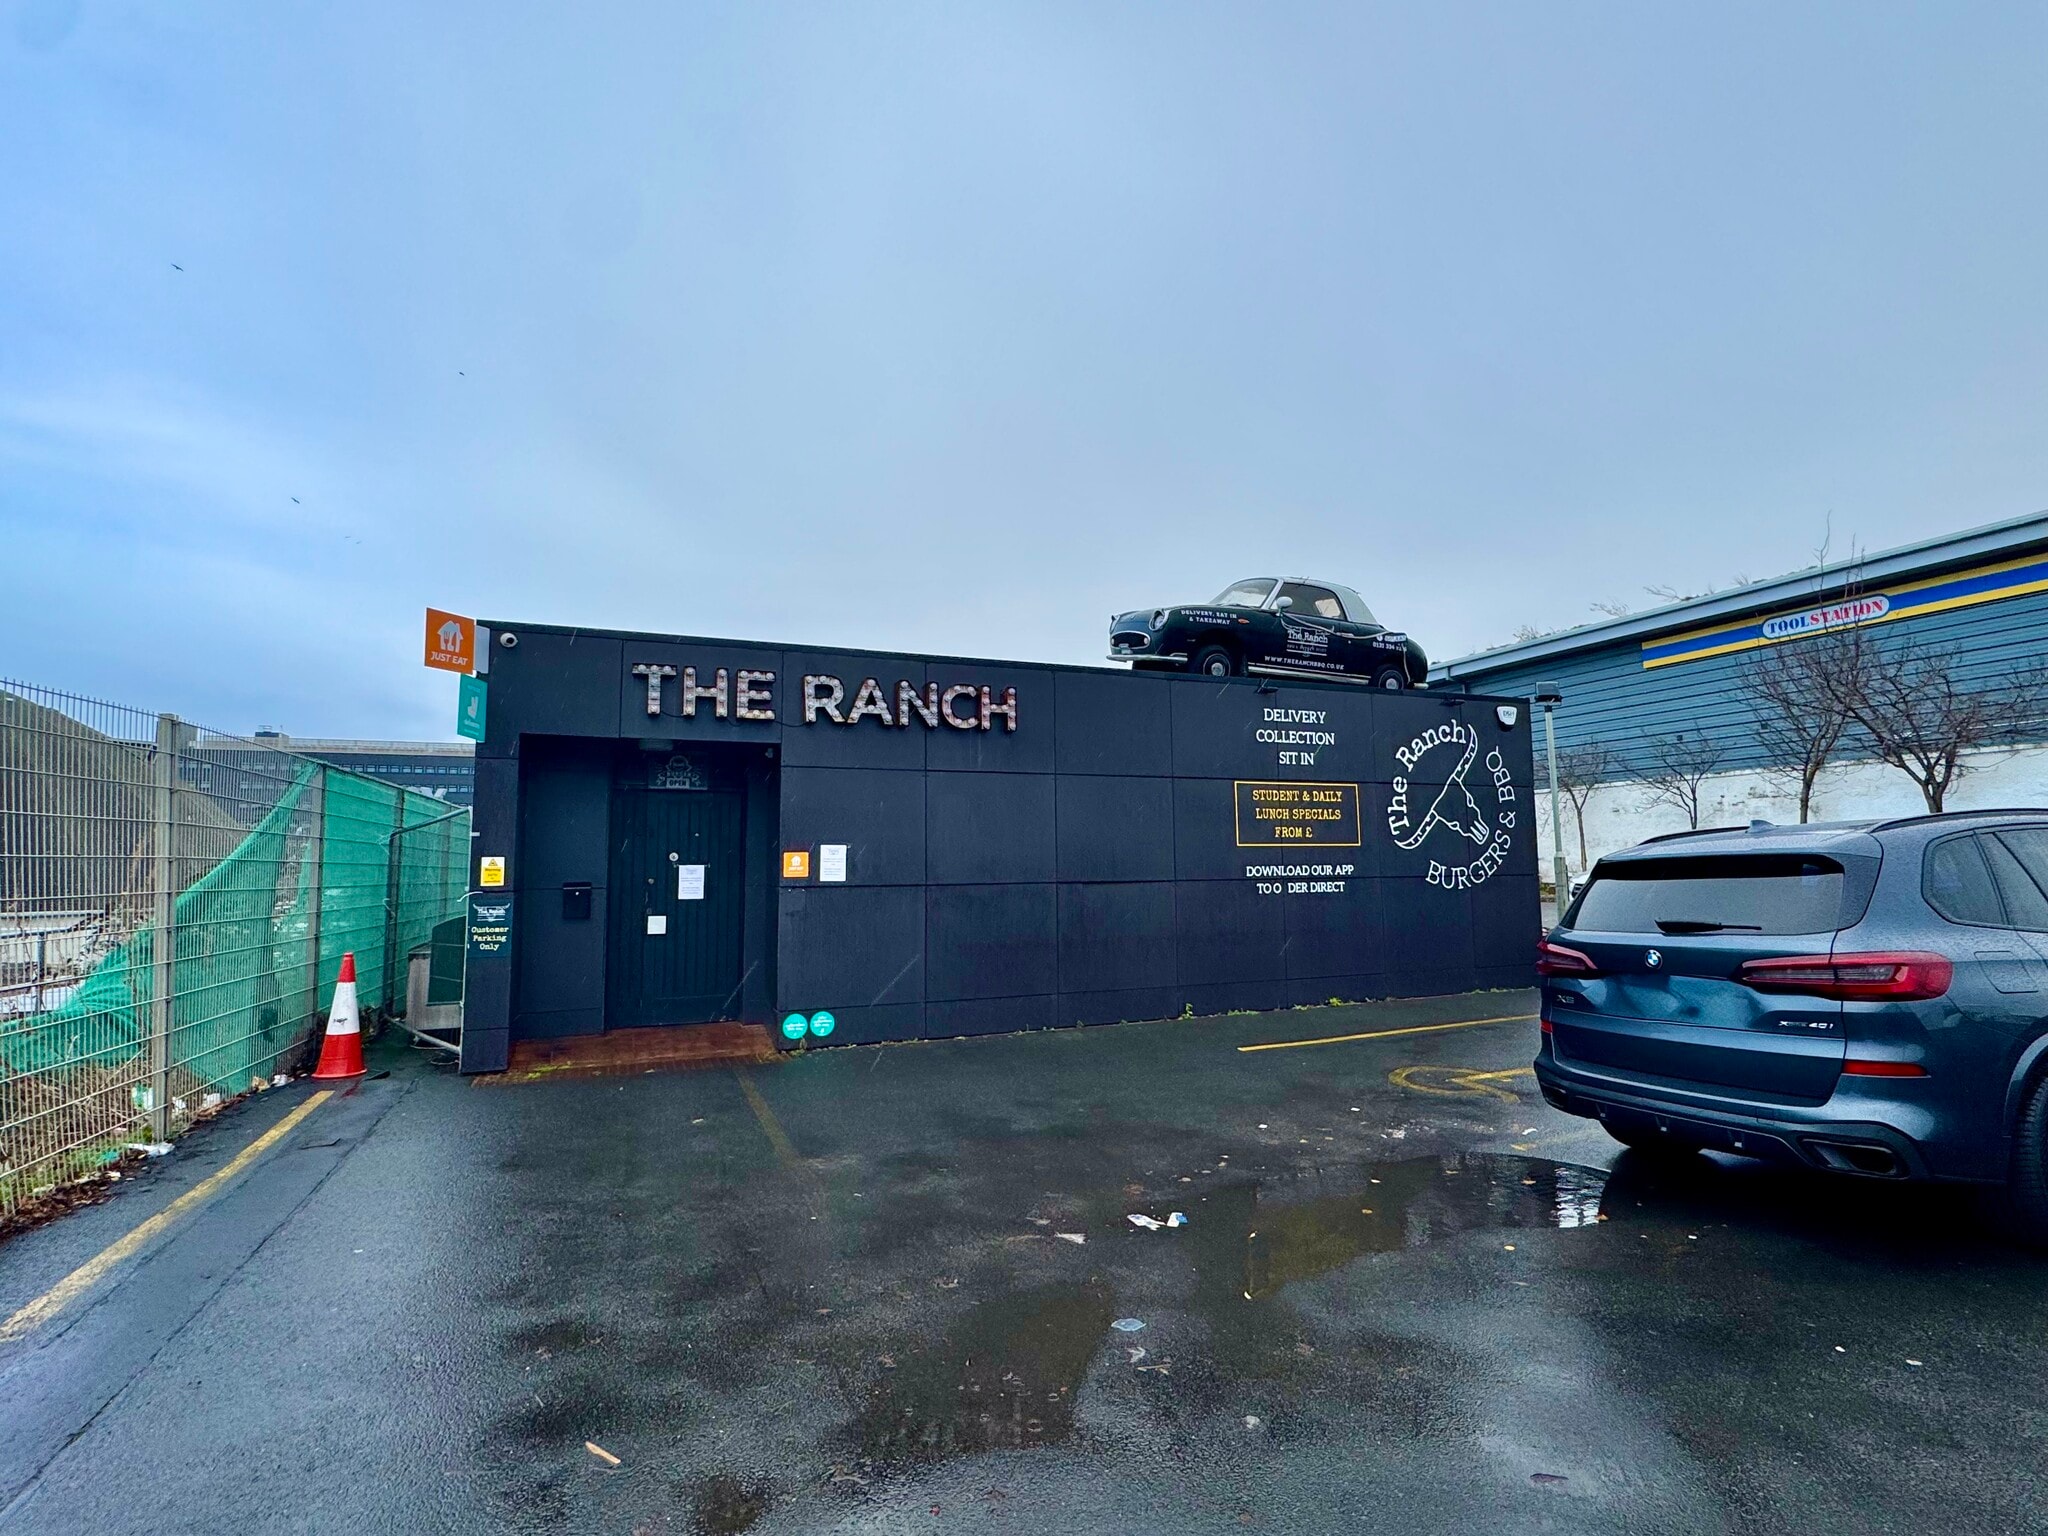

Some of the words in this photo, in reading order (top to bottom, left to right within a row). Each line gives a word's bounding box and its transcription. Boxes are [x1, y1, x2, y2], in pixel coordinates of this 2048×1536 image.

[1195, 617, 1231, 625] TAKEAWAY
[1768, 600, 1884, 635] TOOLSTATION
[1287, 630, 1302, 640] The
[1303, 632, 1329, 644] Ranch
[430, 651, 452, 663] JUST
[452, 655, 469, 666] EAT
[632, 663, 777, 720] THE
[803, 673, 1018, 732] RANCH
[1263, 708, 1327, 724] DELIVERY
[1255, 729, 1335, 745] COLLECTION
[1395, 718, 1466, 772] Ranch
[1279, 751, 1298, 765] SIT
[1300, 752, 1314, 765] IN
[1485, 745, 1516, 804] BBQ
[1252, 790, 1300, 801] STUDENT
[1302, 790, 1310, 801] &
[1312, 790, 1342, 802] DAILY
[1387, 775, 1410, 836] The
[1255, 808, 1289, 819] LUNCH
[1292, 808, 1341, 820] SPECIALS
[1499, 810, 1516, 828] &
[1275, 826, 1303, 838] FROM
[1305, 827, 1313, 838] £
[1424, 829, 1511, 890] BURGERS
[1246, 865, 1310, 877] DOWNLOAD
[1311, 865, 1333, 876] OUR
[1334, 864, 1355, 875] APP
[1256, 883, 1272, 894] TO
[1310, 881, 1345, 893] DIRECT
[473, 934, 507, 943] Parking
[479, 943, 500, 951] Only
